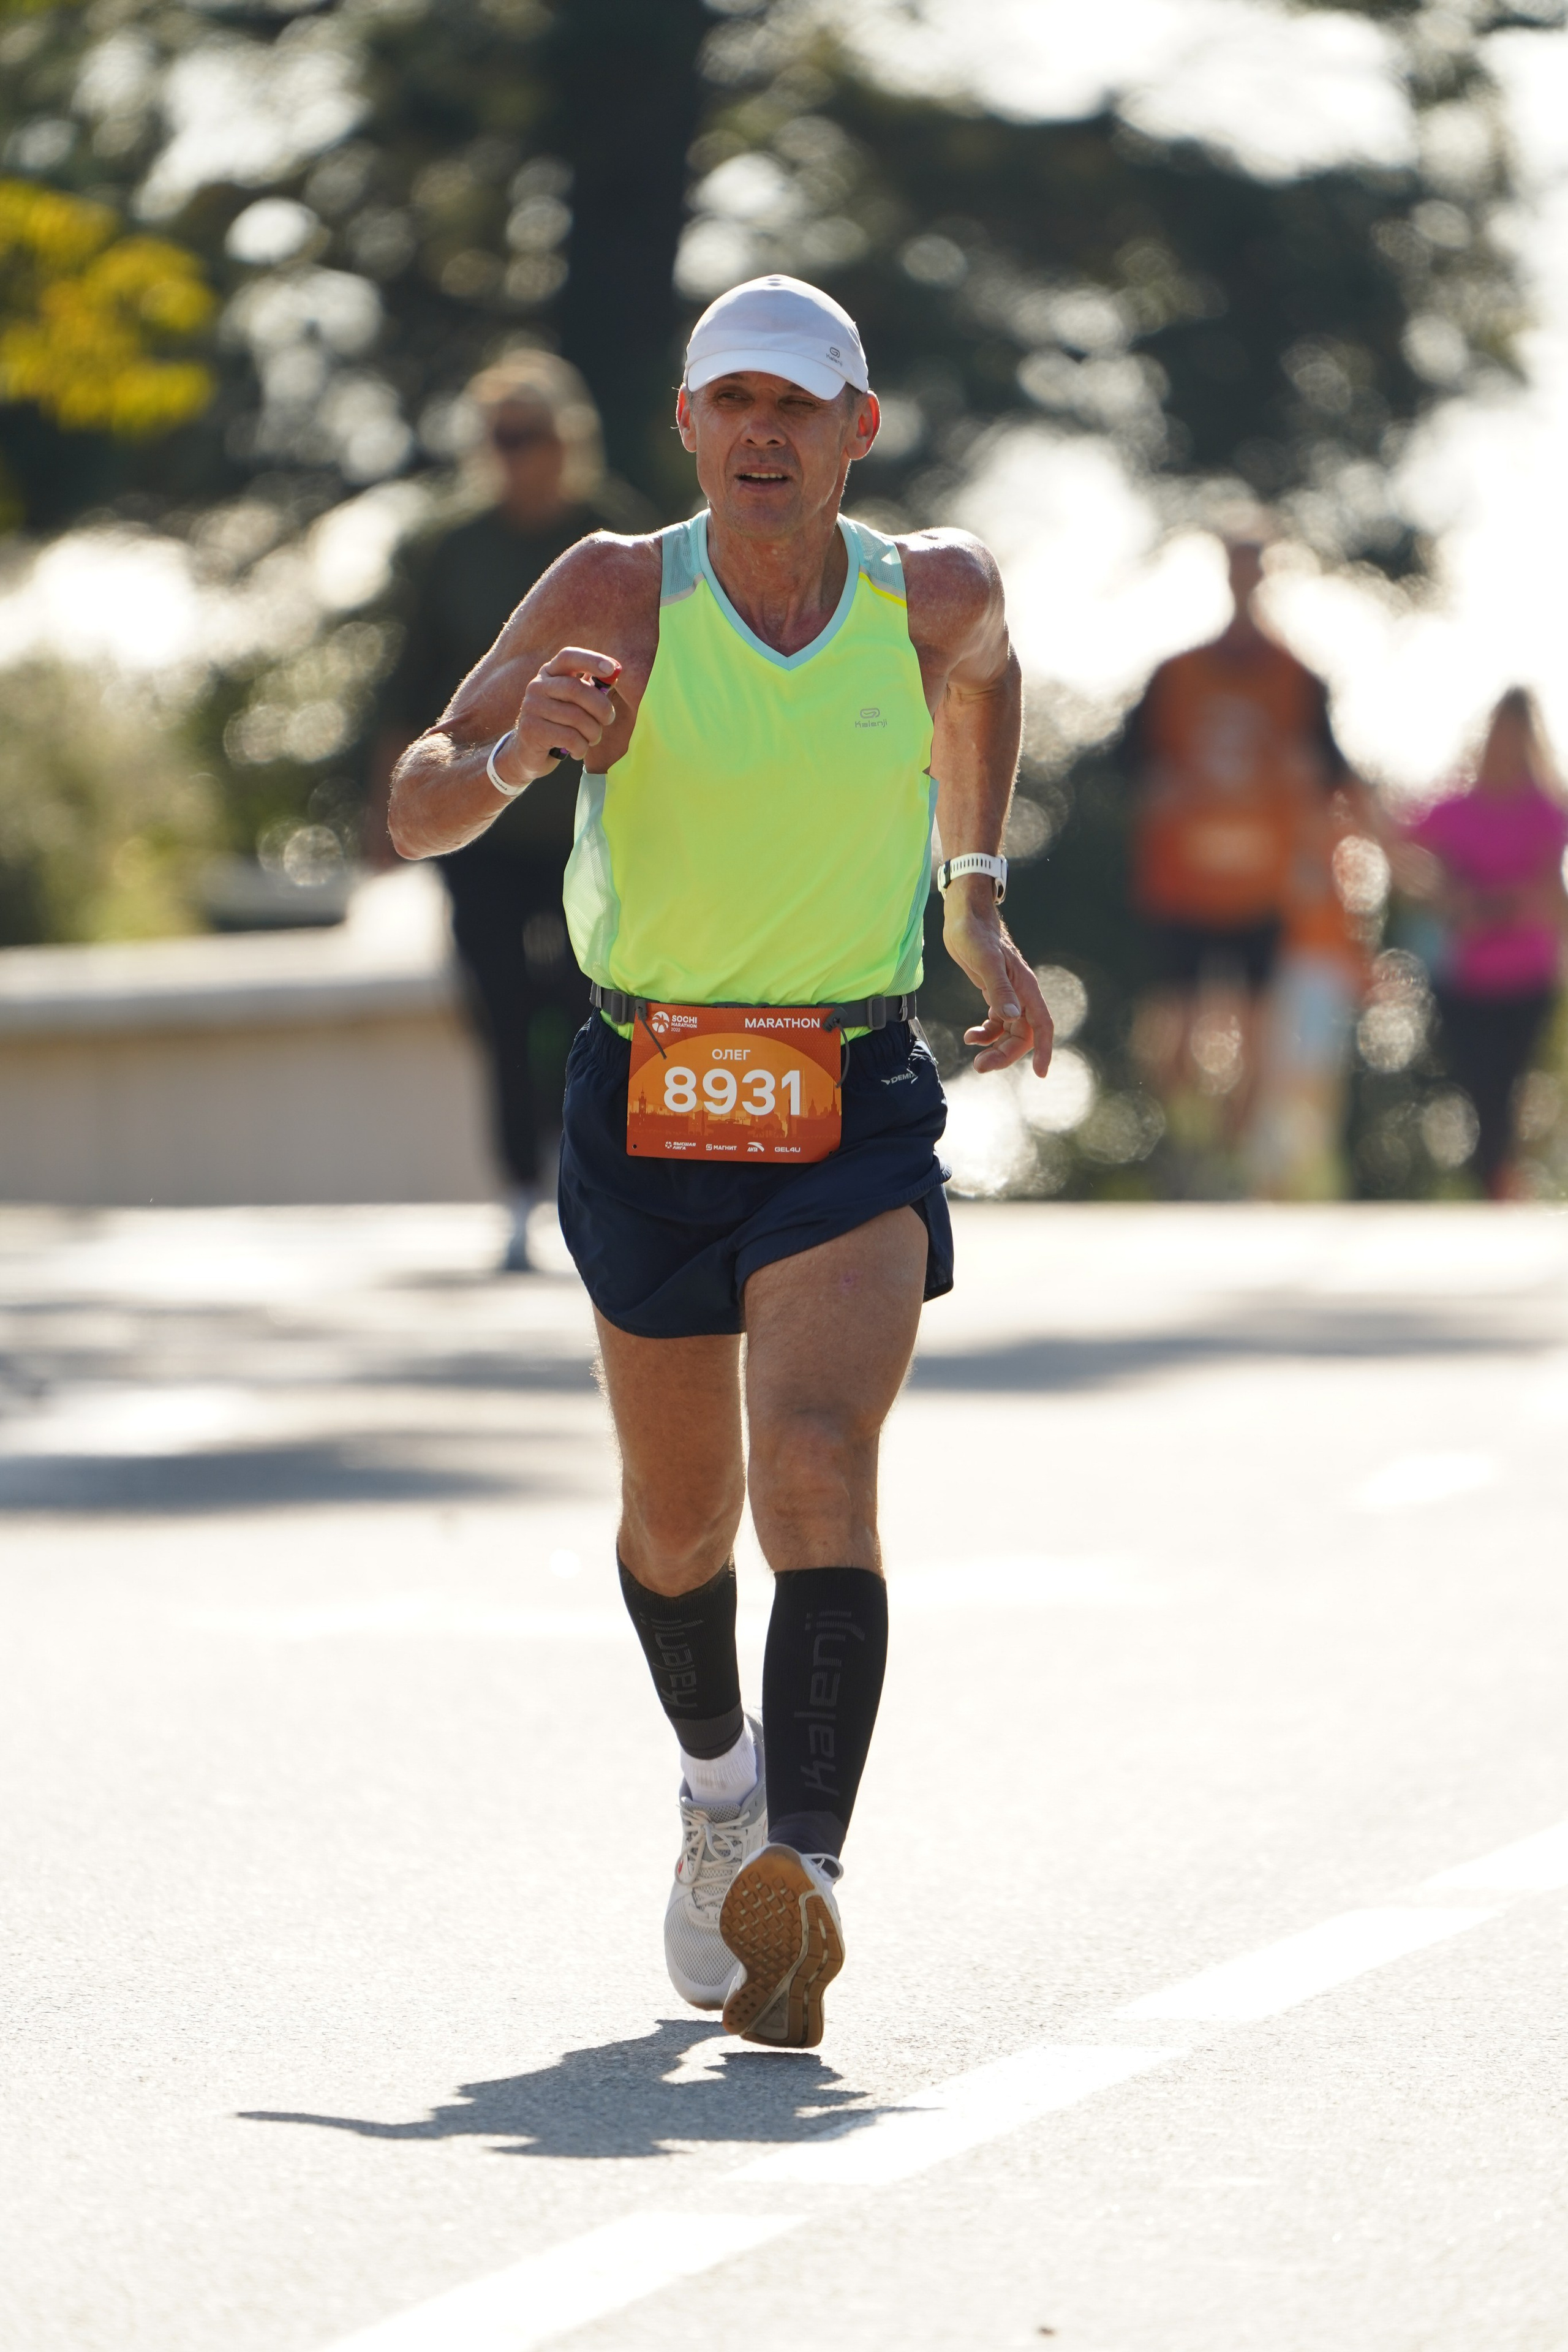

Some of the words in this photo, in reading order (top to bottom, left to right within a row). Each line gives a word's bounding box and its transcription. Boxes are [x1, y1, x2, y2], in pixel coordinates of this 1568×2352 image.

[854, 719, 888, 728] Kalenji
[671, 1015, 697, 1023] SOCHI
[744, 1017, 821, 1028] MARATHON
[711, 1049, 751, 1060] ОЛЕГ
[663, 1066, 801, 1116] 8931
